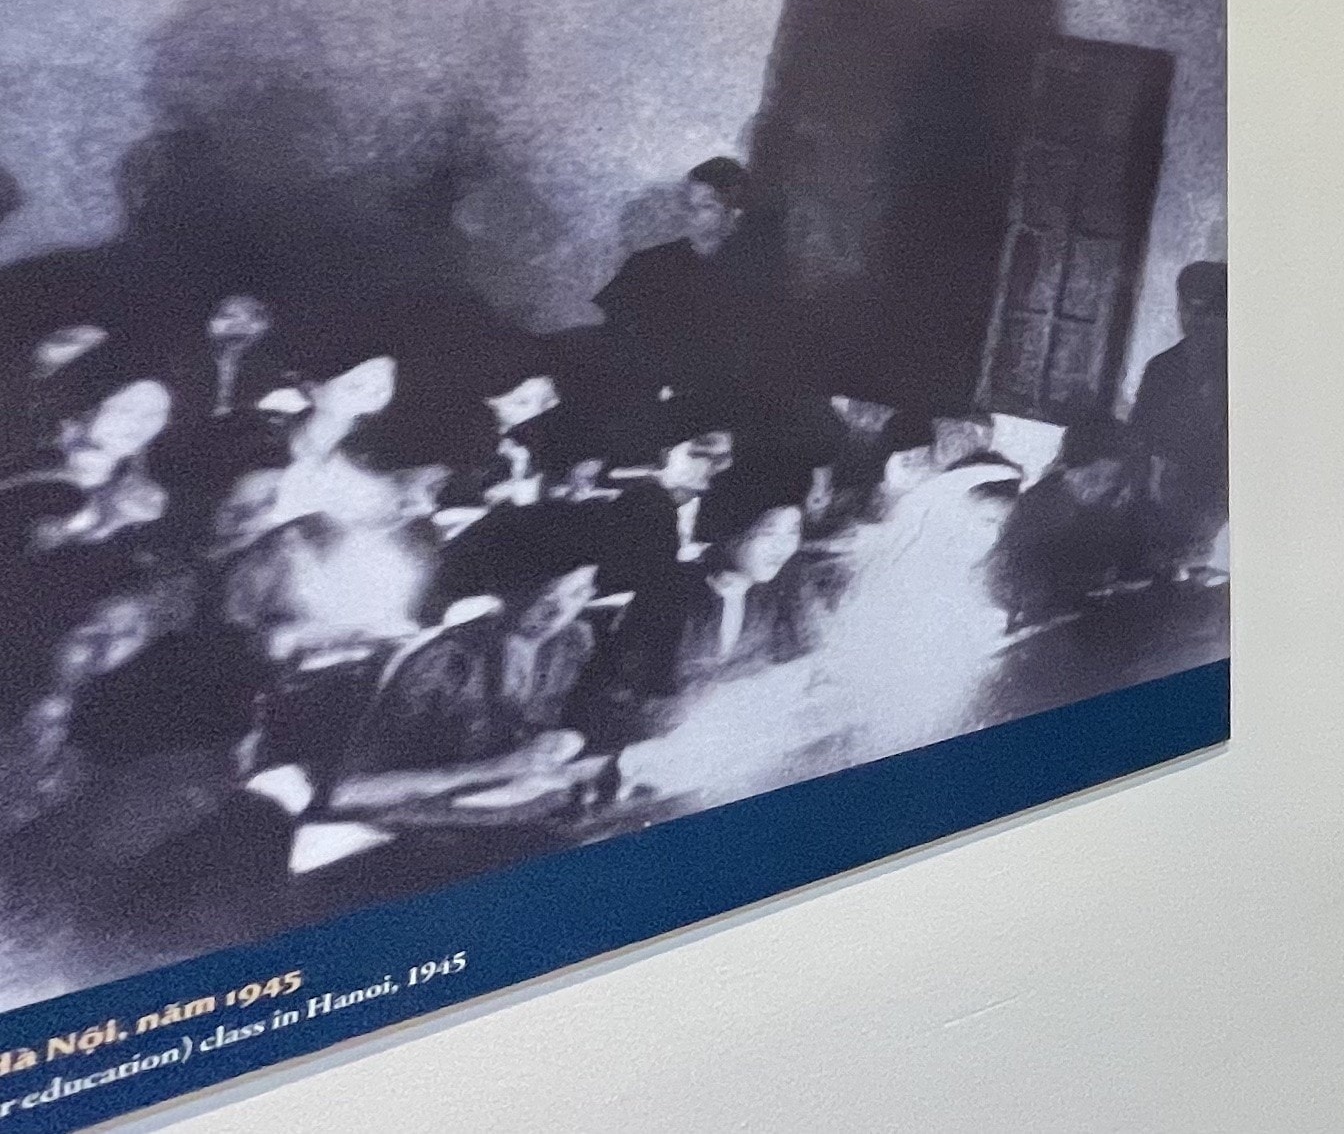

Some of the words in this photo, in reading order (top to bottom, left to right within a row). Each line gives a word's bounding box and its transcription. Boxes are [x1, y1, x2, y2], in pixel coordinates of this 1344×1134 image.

[22, 1035, 193, 1109] education)
[200, 1019, 266, 1052] class
[272, 1007, 299, 1030] in
[306, 974, 399, 1021] Hanoi,
[407, 950, 467, 987] 1945
[135, 996, 217, 1034] năm
[226, 969, 302, 1008] 1945
